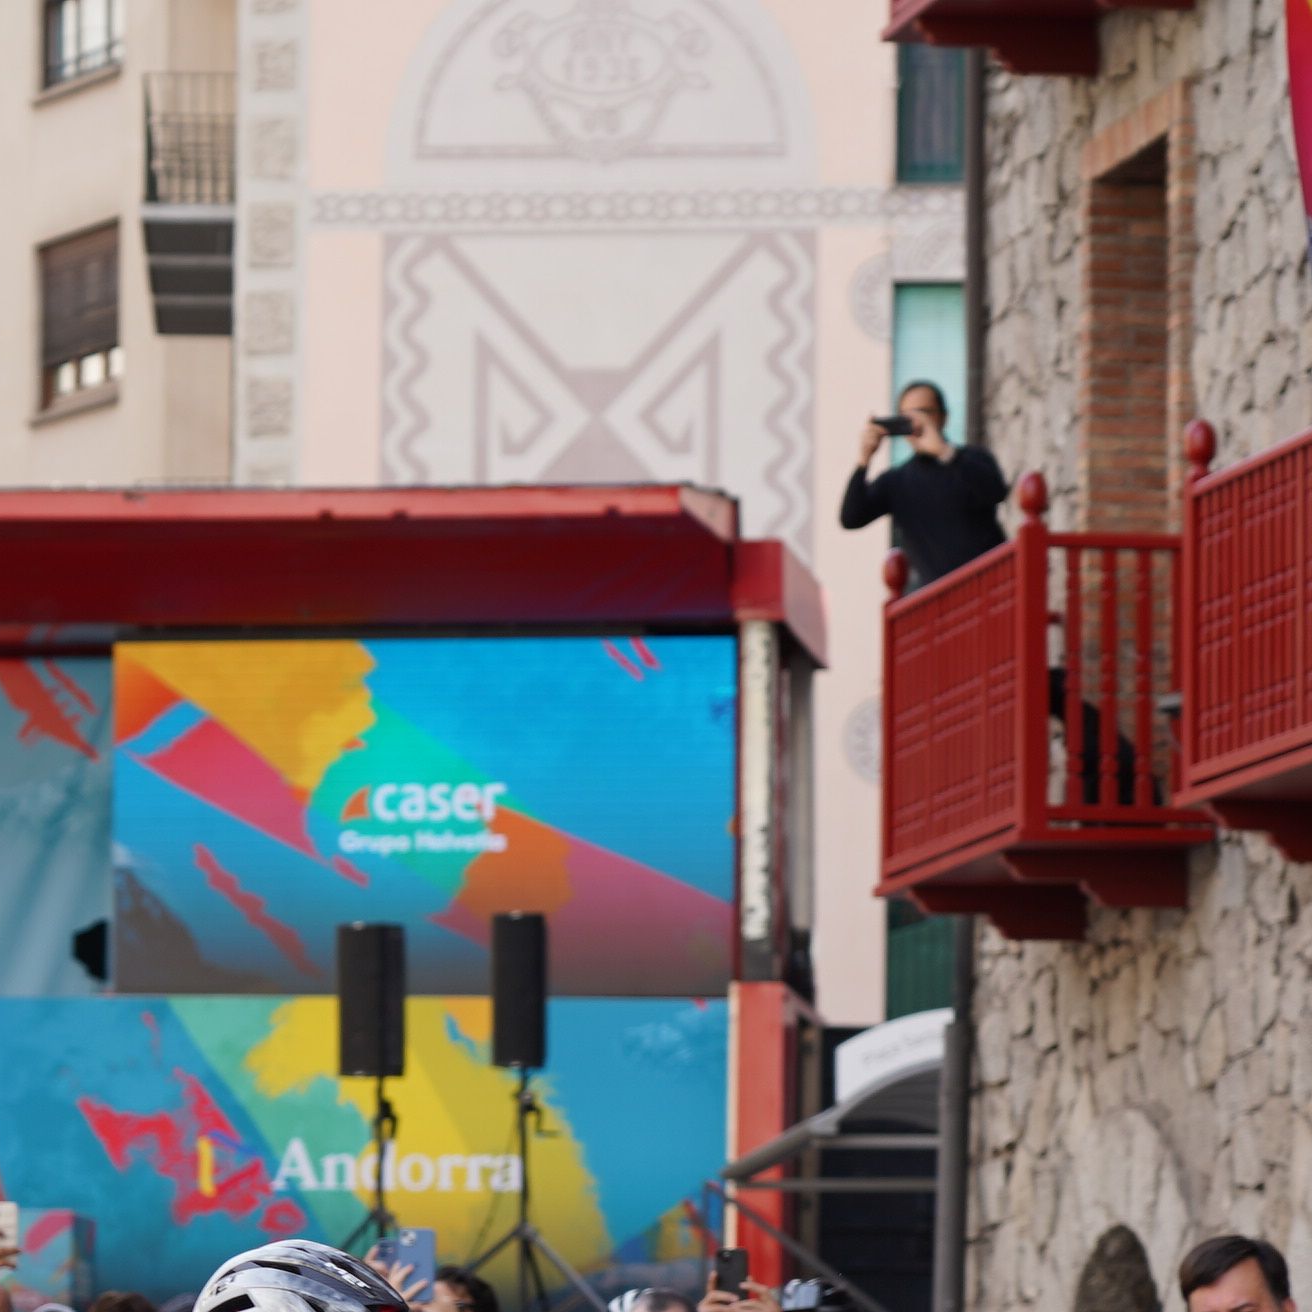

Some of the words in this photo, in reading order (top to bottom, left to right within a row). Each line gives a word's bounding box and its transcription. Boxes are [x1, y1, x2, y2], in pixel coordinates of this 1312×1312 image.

[373, 782, 508, 823] caser
[271, 1137, 524, 1192] Andorra
[325, 1262, 371, 1289] MET
